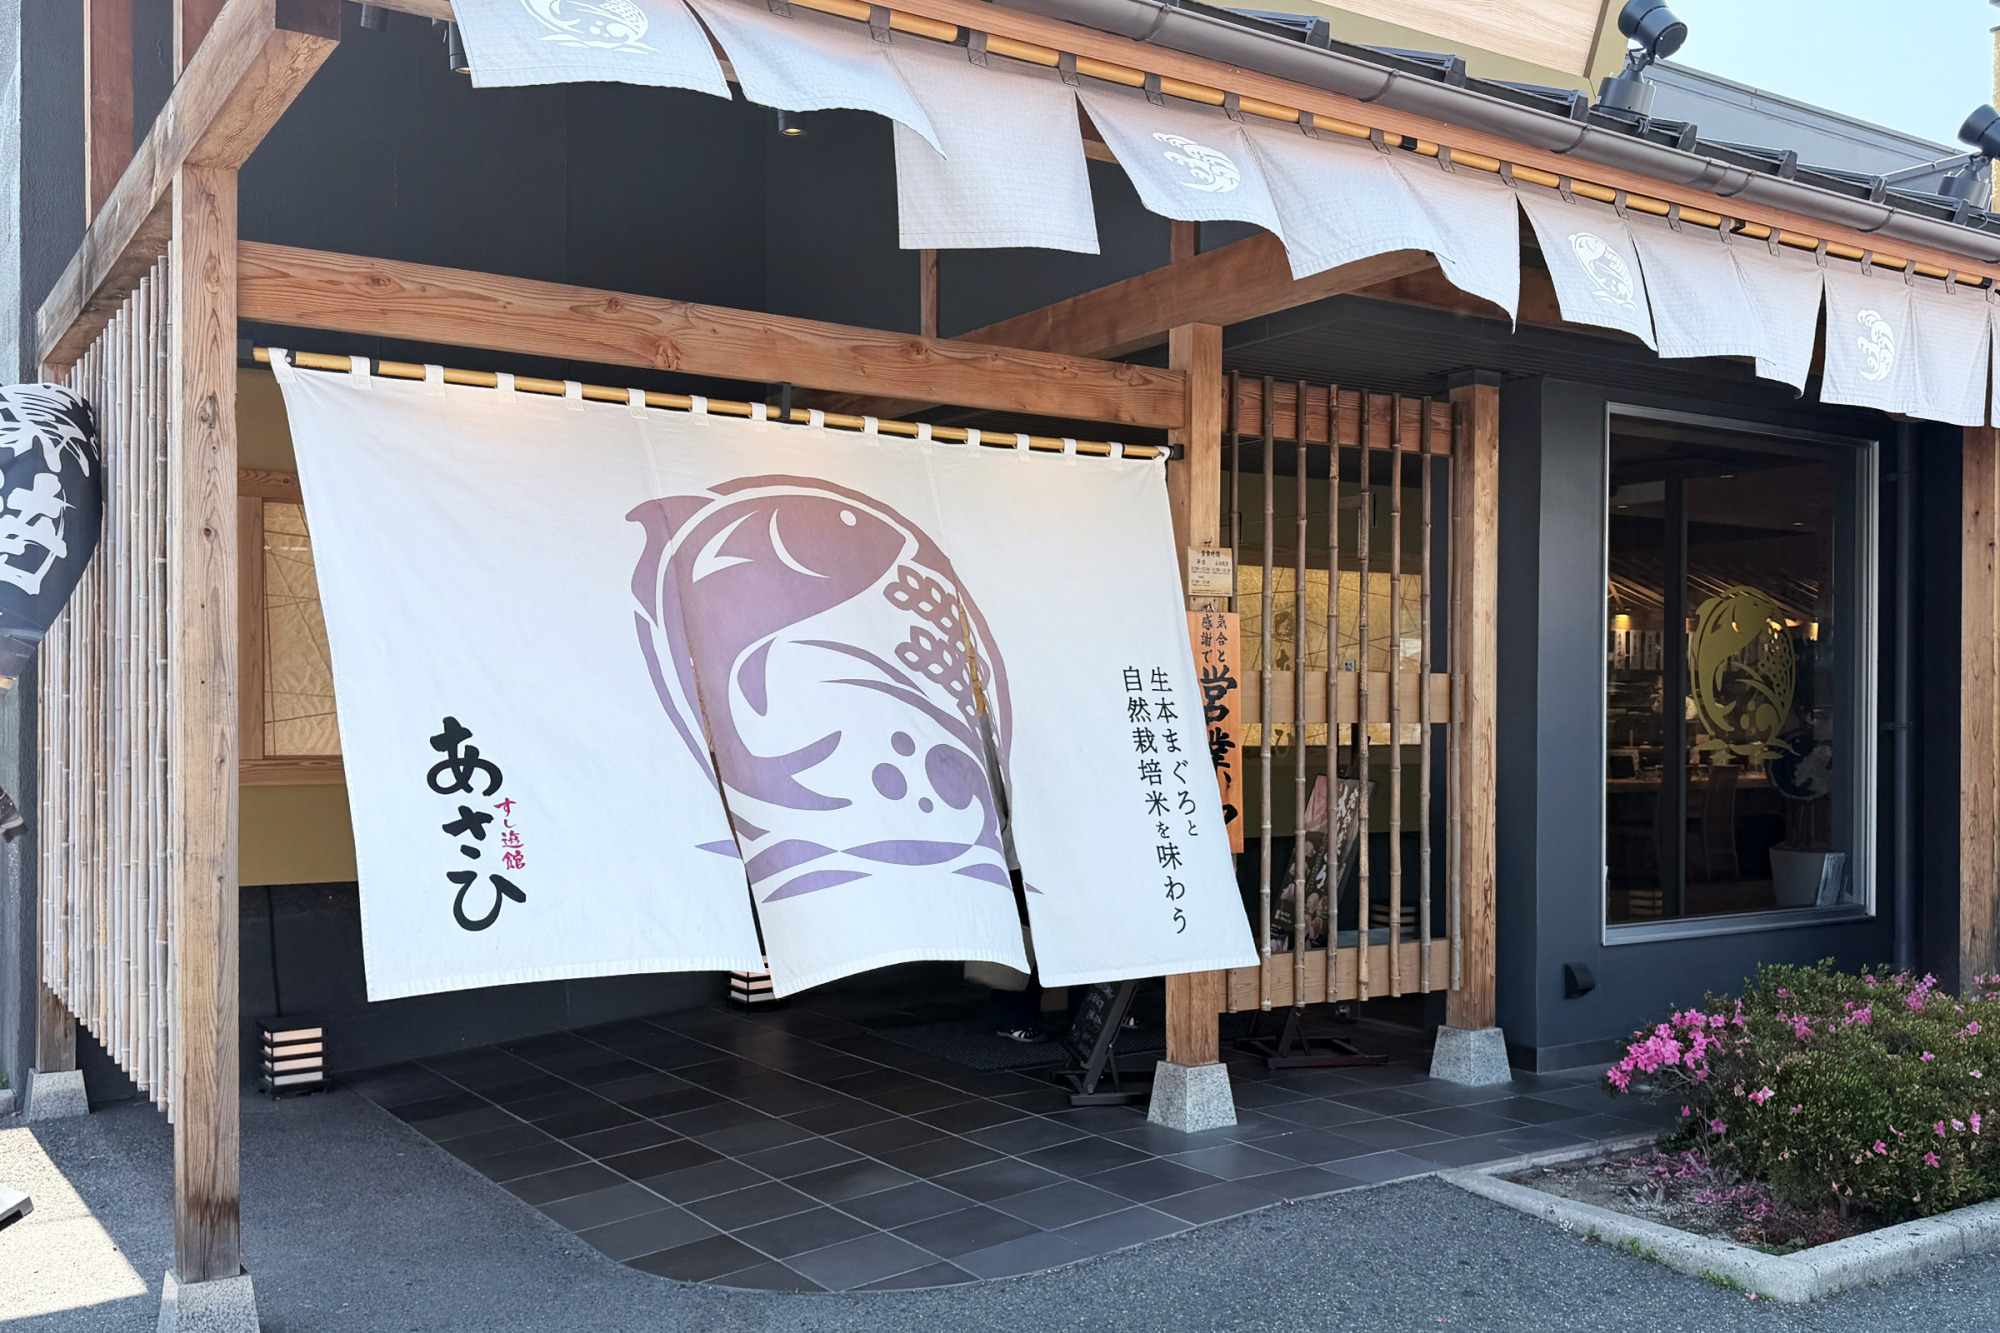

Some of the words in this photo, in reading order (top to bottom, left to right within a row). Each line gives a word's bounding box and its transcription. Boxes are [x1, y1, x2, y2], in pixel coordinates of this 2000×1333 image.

[1200, 613, 1213, 664] 感謝で
[1215, 613, 1228, 663] 気合と
[1122, 665, 1187, 934] 自然栽培米を味わう
[1150, 666, 1199, 837] 生本まぐろと
[426, 716, 527, 932] あさひ
[493, 797, 526, 871] すし遊館
